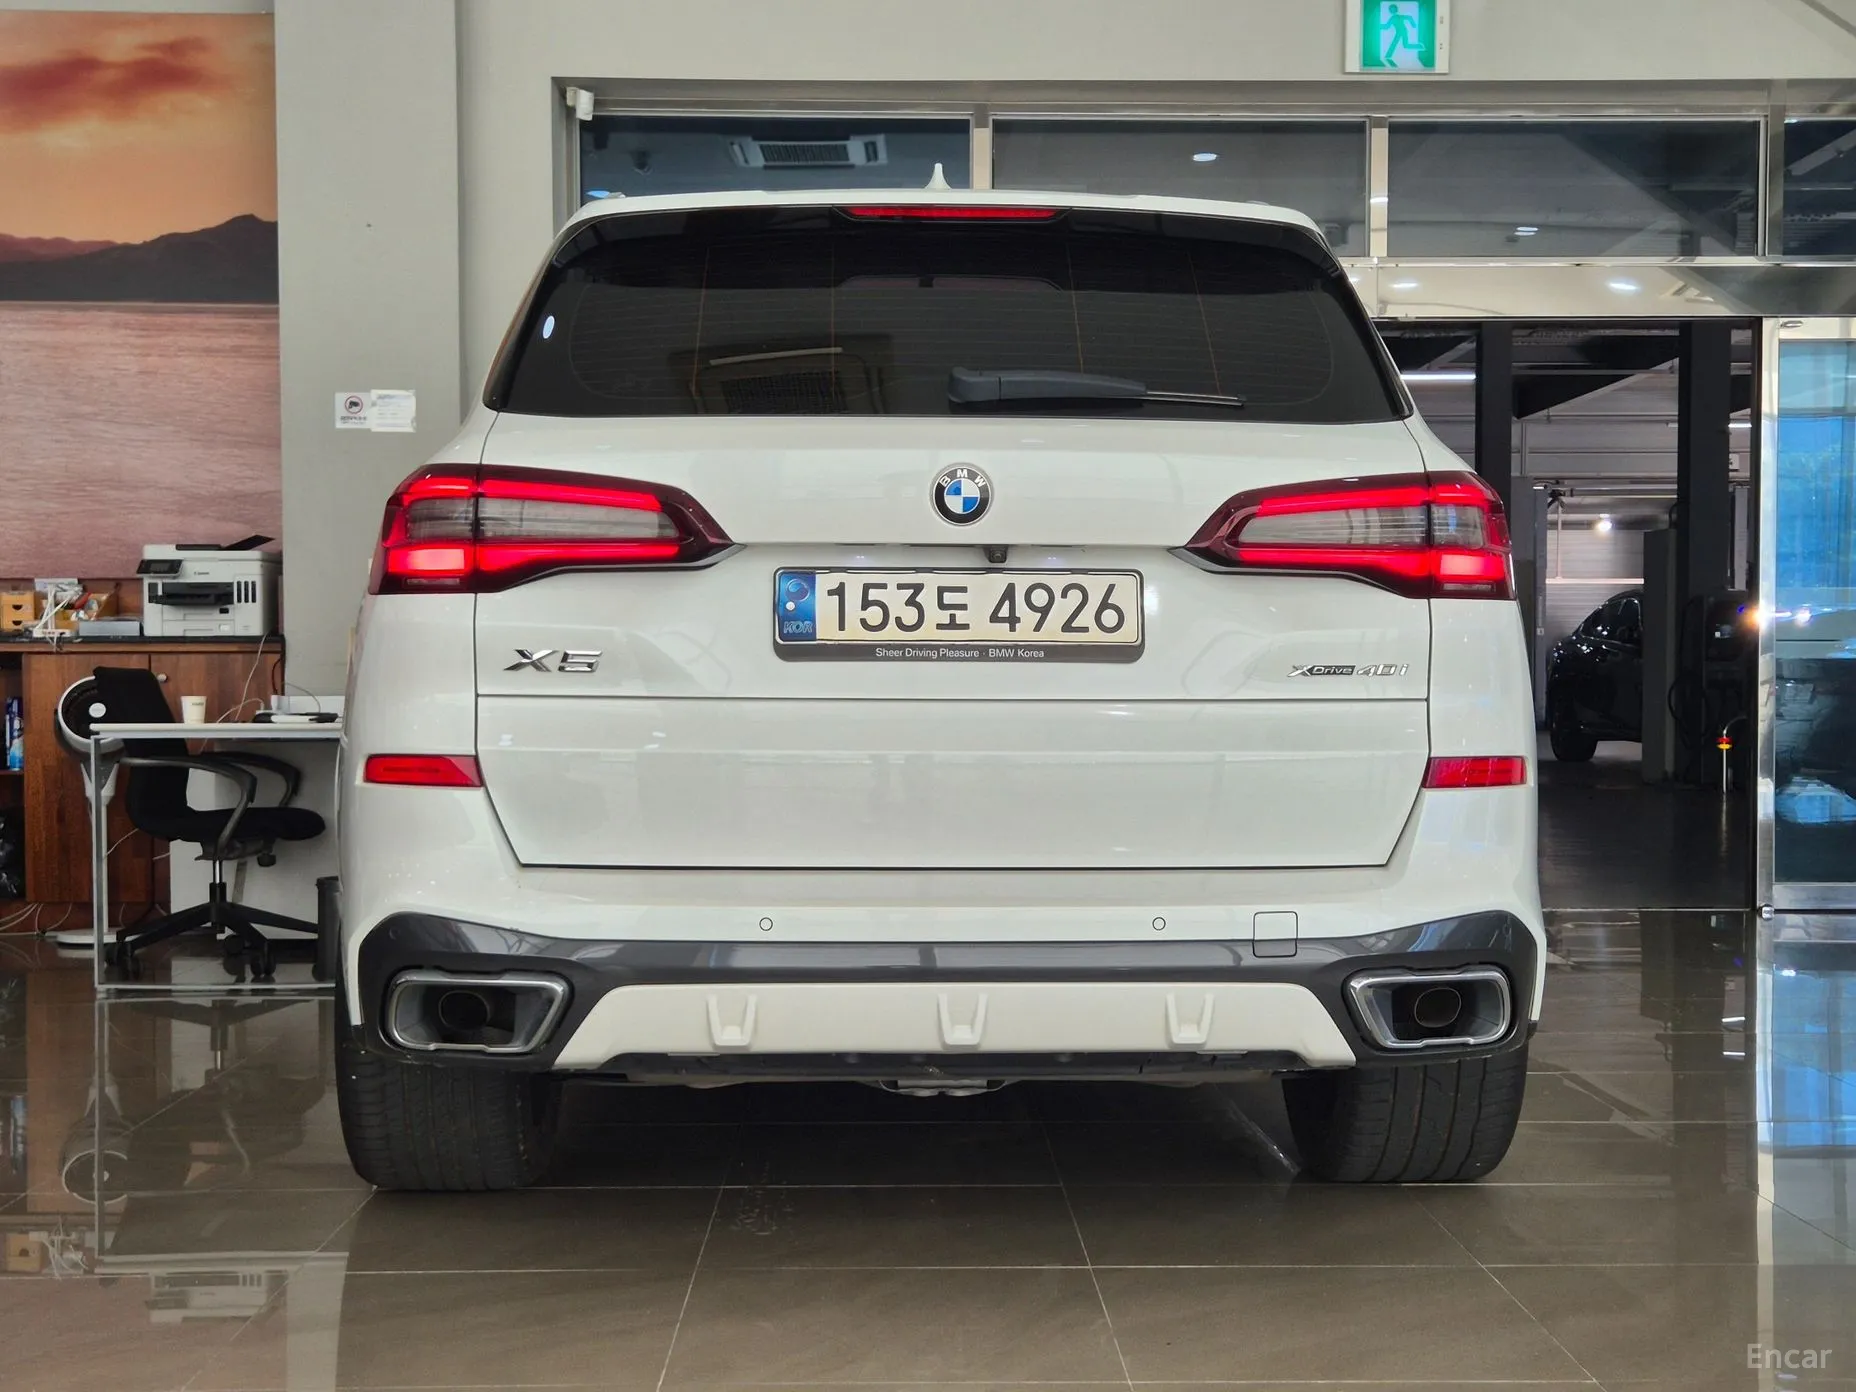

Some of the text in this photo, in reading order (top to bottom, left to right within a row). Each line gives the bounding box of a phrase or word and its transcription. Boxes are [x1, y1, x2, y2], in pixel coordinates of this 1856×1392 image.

[939, 469, 986, 488] BMW
[827, 581, 1125, 634] 153도 4926
[783, 620, 813, 634] KOR
[503, 648, 603, 673] X5
[875, 647, 1045, 659] Sheer Driving Pleasure BMW Korea
